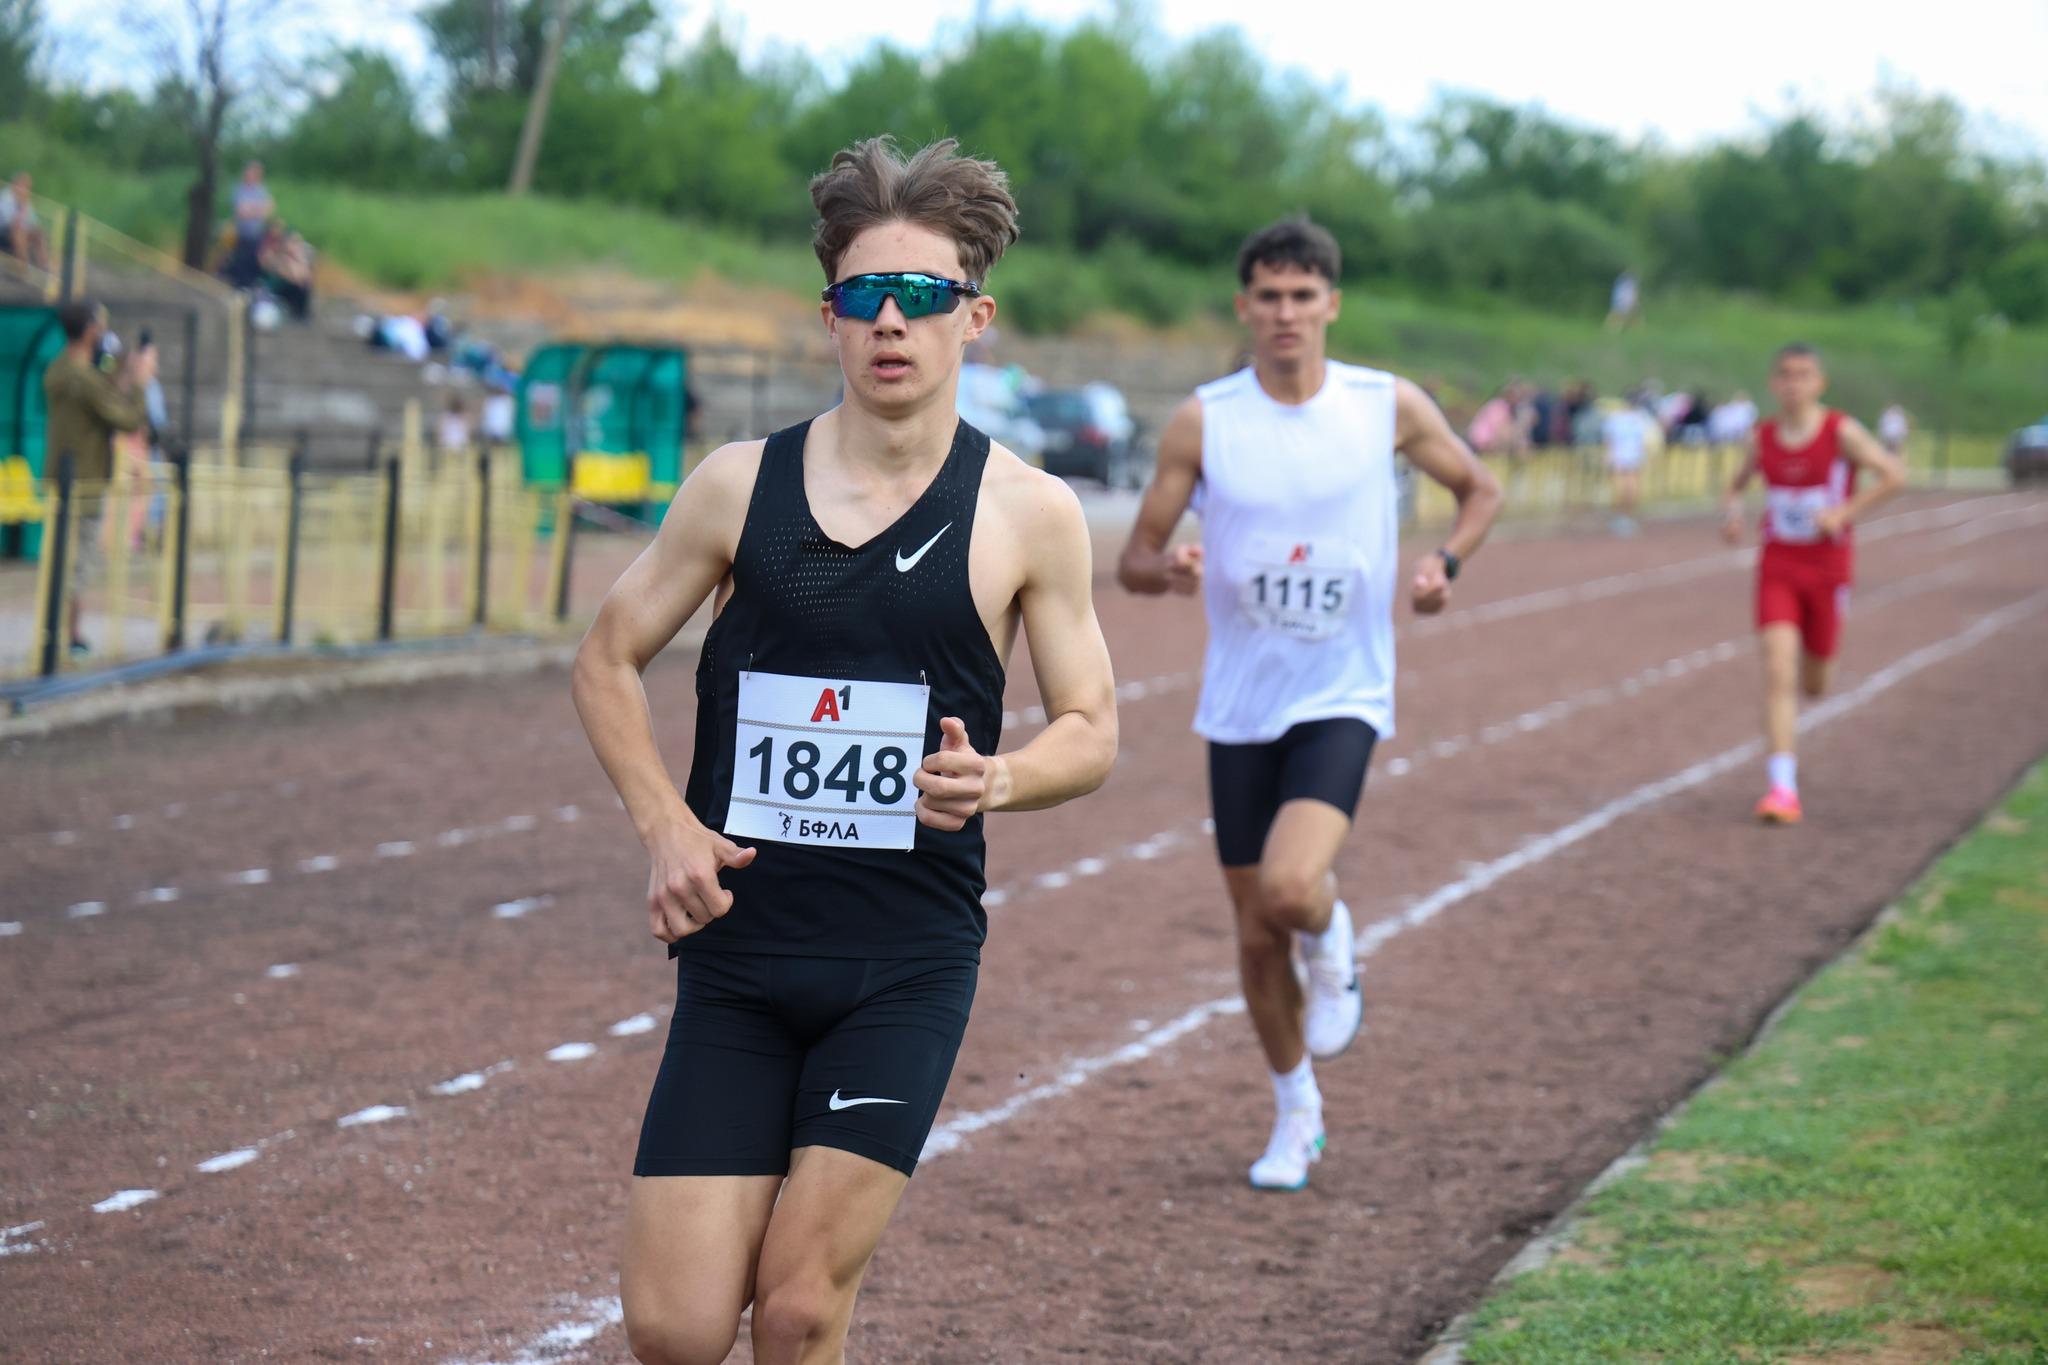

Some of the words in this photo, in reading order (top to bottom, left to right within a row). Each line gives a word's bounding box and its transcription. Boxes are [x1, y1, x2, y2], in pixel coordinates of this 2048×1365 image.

[1252, 573, 1343, 614] 1115
[811, 685, 851, 722] A1
[749, 736, 908, 804] 1848
[799, 819, 859, 840] БФЛА
